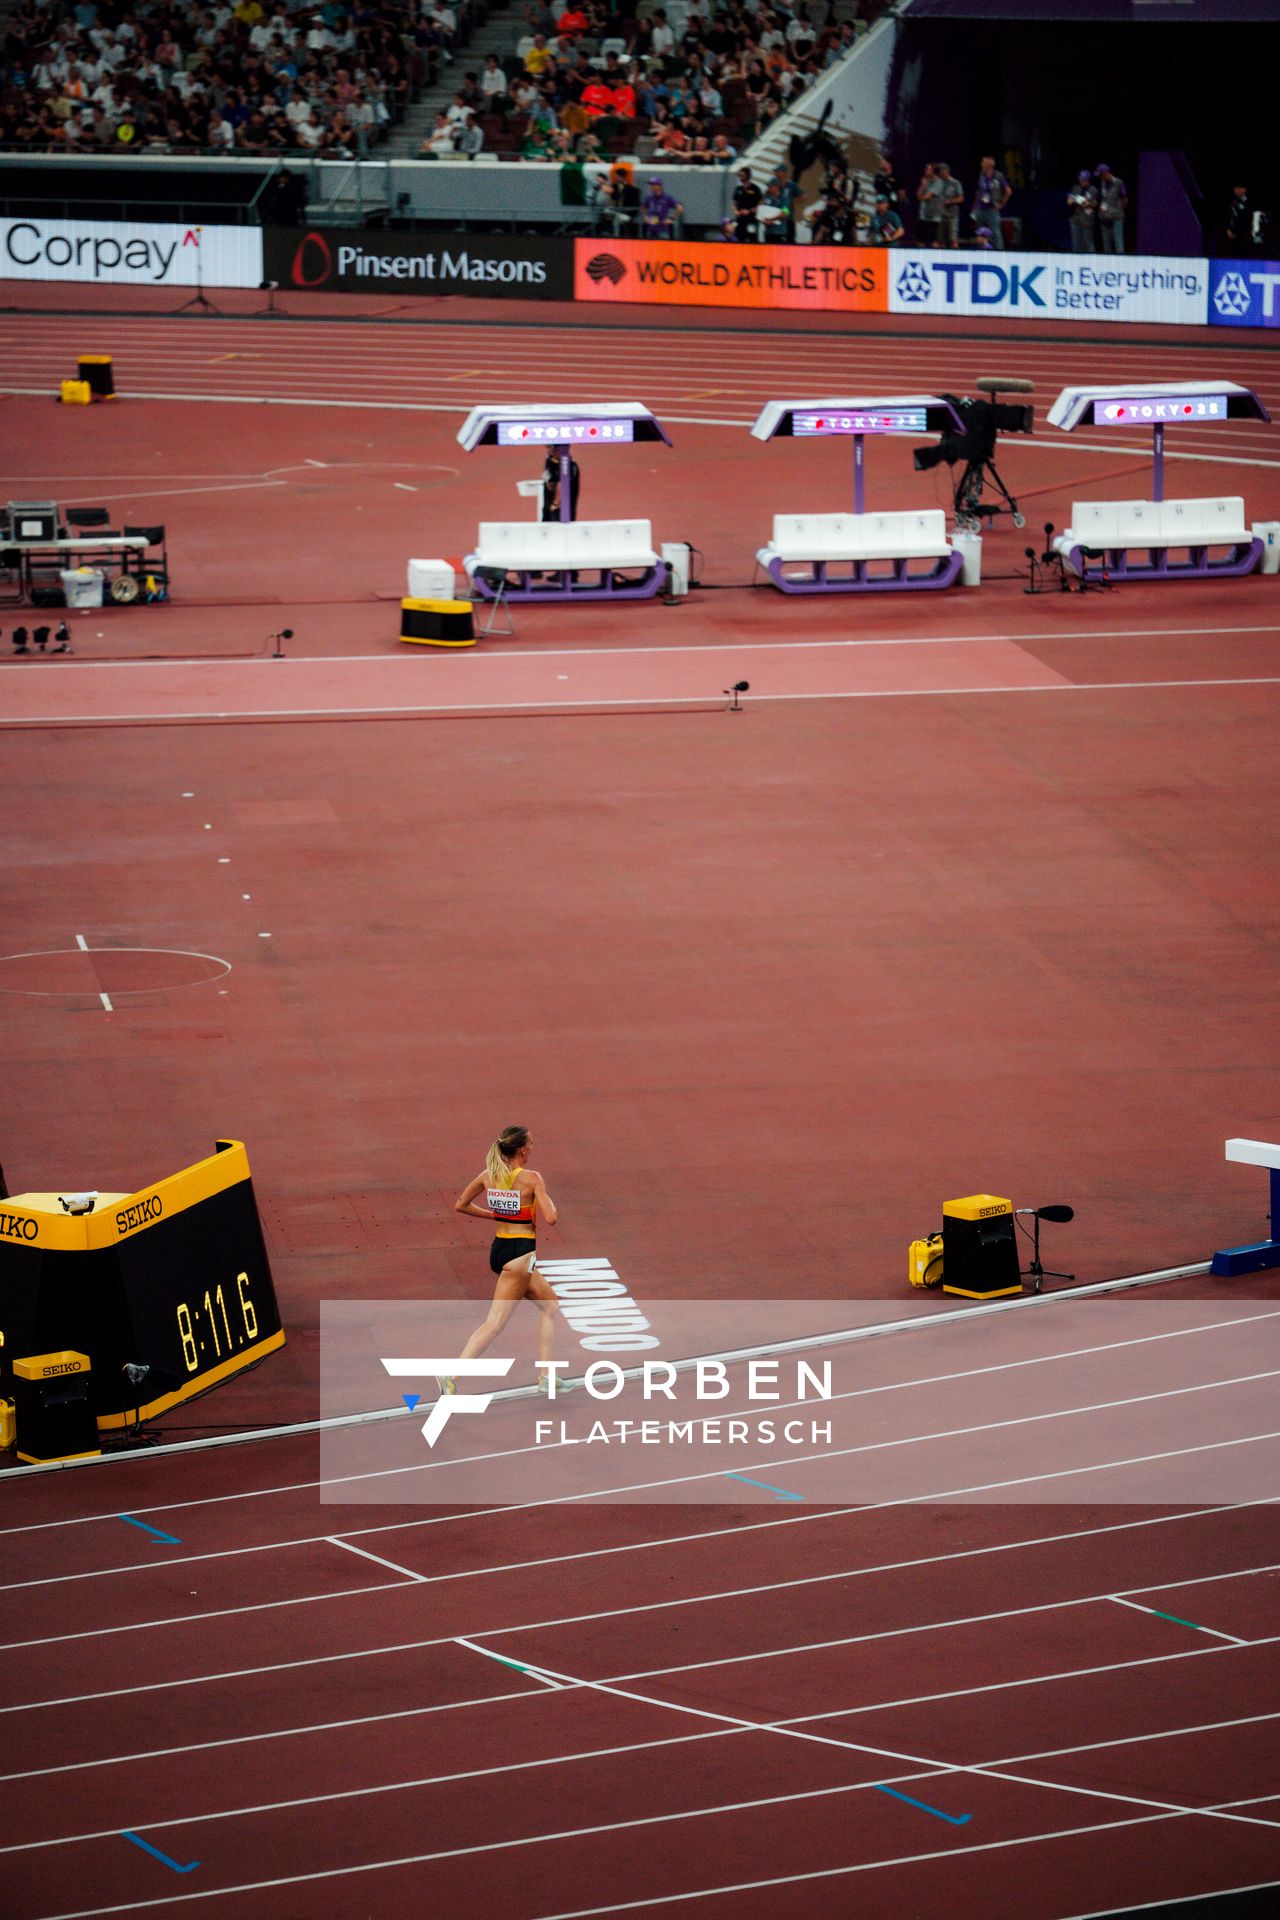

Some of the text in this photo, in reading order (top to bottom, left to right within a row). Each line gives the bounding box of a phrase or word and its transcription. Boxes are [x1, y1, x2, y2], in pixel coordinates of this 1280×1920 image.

[6, 223, 178, 280] Corpay
[337, 246, 547, 283] Pinsent Masons
[636, 260, 876, 292] WORLD ATHLETICS
[932, 263, 1048, 307] TDK
[1055, 266, 1203, 295] In Everything,
[1055, 289, 1124, 311] Better
[115, 1195, 163, 1235] SEIKO
[489, 1200, 518, 1209] MEYER
[979, 1204, 1007, 1217] SEIKO
[177, 1271, 258, 1372] 8:11.6
[42, 1361, 82, 1376] SEIKO
